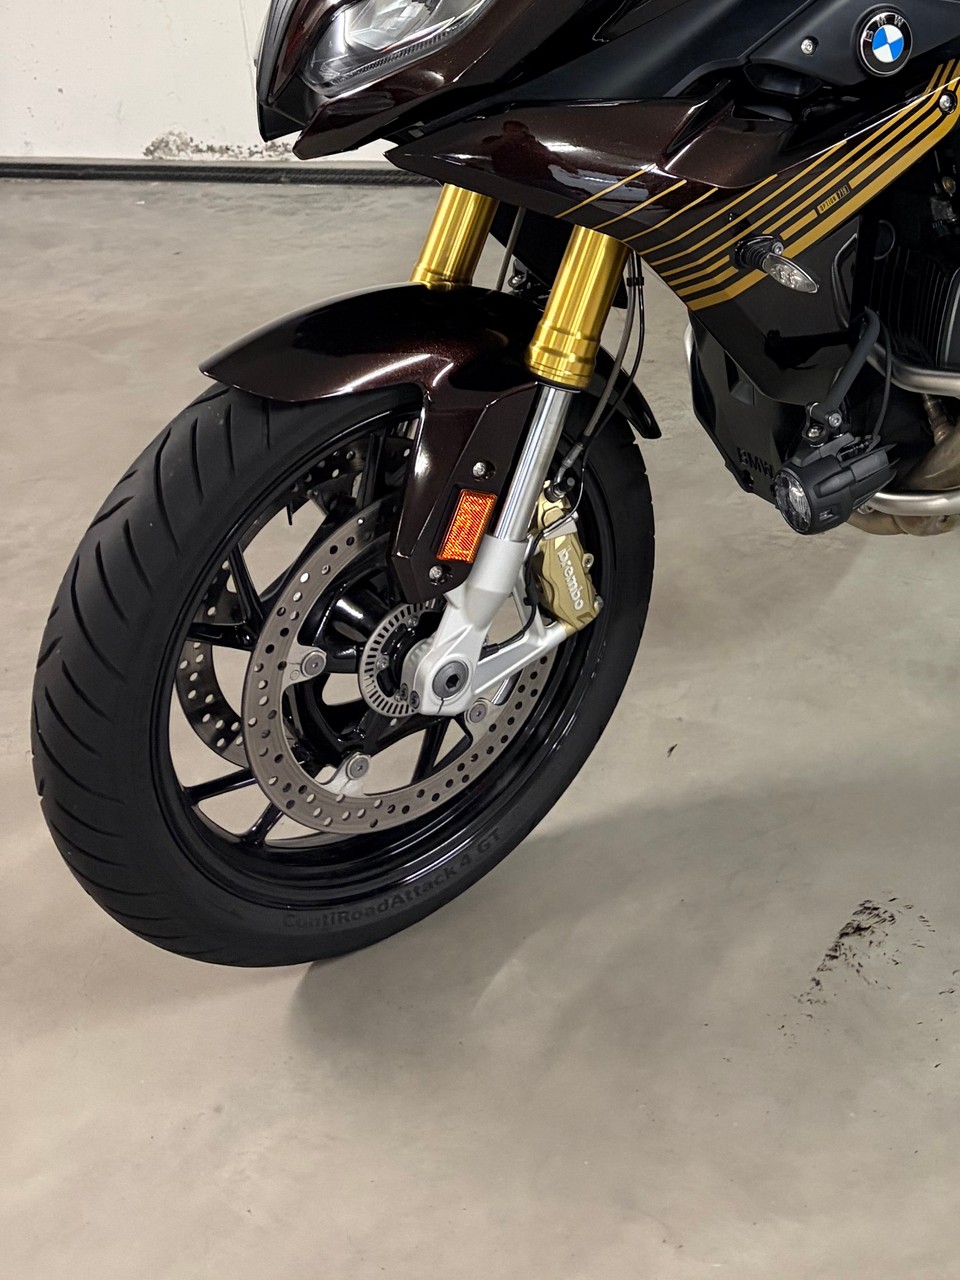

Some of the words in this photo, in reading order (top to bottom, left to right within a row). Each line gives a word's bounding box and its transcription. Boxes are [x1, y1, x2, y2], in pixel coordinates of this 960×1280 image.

[864, 14, 905, 43] BMW
[736, 447, 774, 479] BMW
[557, 545, 584, 610] brembo
